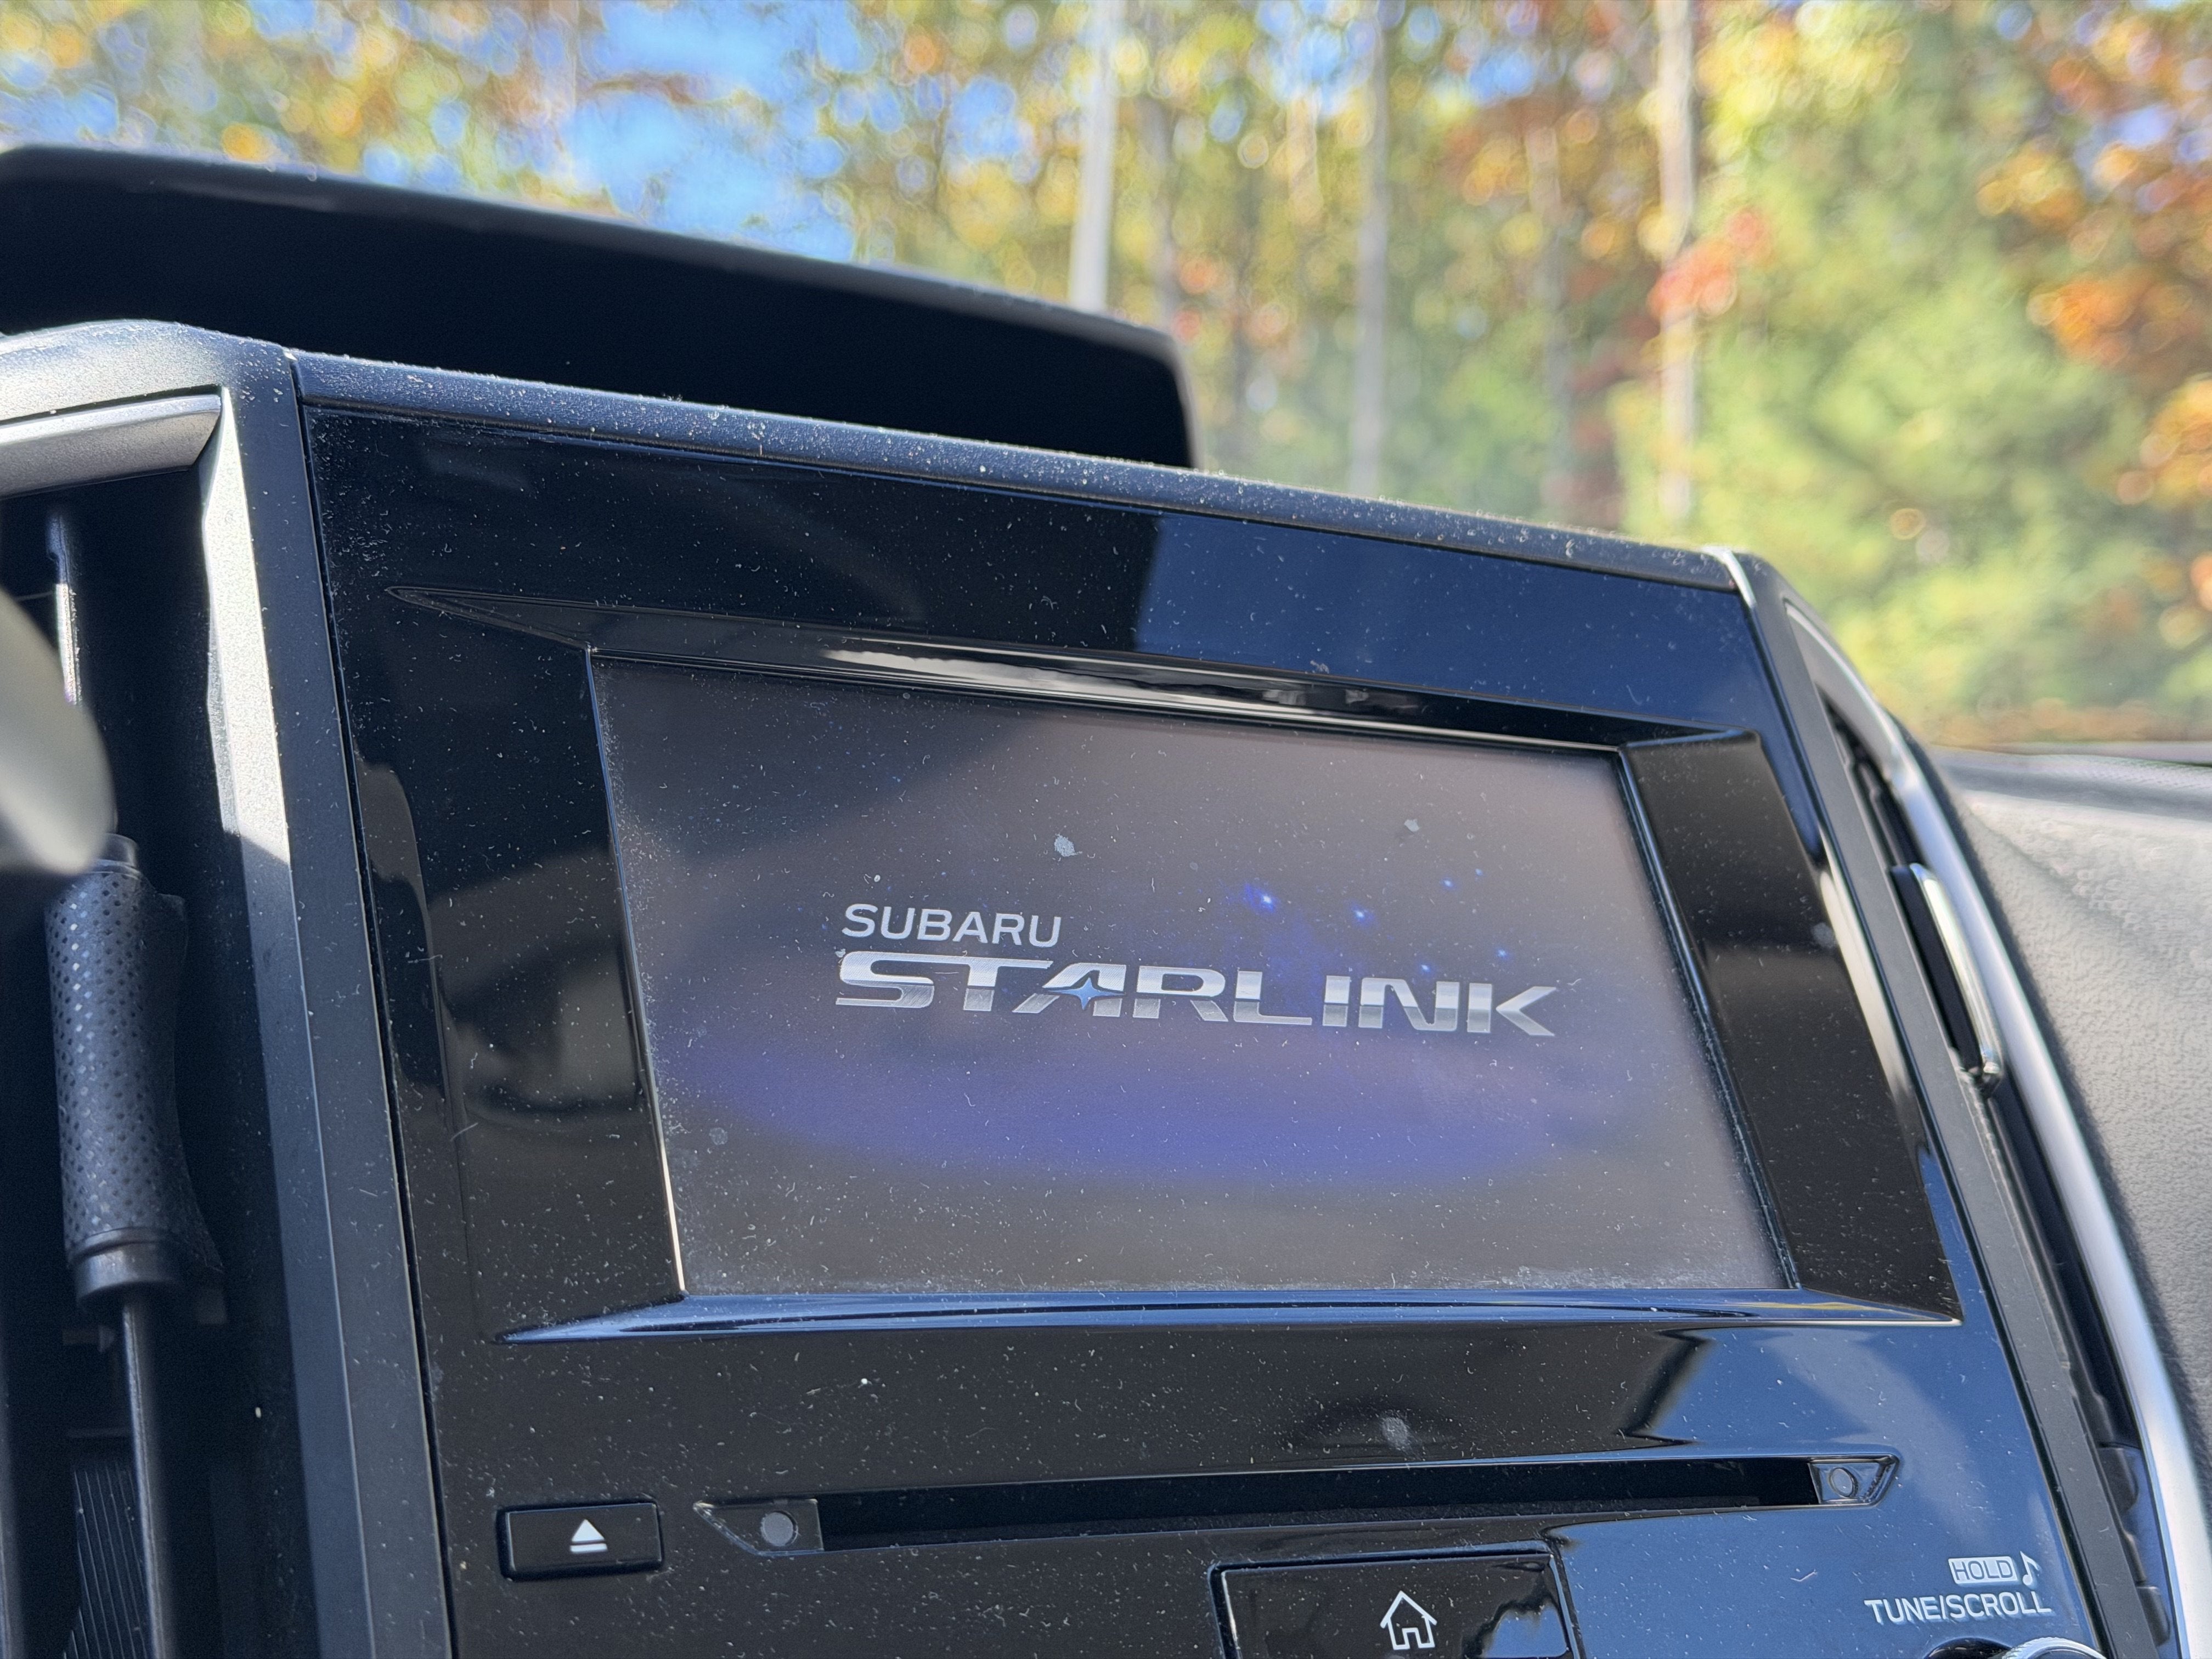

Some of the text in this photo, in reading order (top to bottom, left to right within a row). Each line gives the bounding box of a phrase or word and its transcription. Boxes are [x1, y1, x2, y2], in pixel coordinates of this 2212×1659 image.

[842, 903, 1062, 947] SUBARU
[835, 951, 1556, 1037] STARLINK
[1951, 1559, 2015, 1582] HOLD
[1864, 1591, 2052, 1624] TUNE/SCROLL
